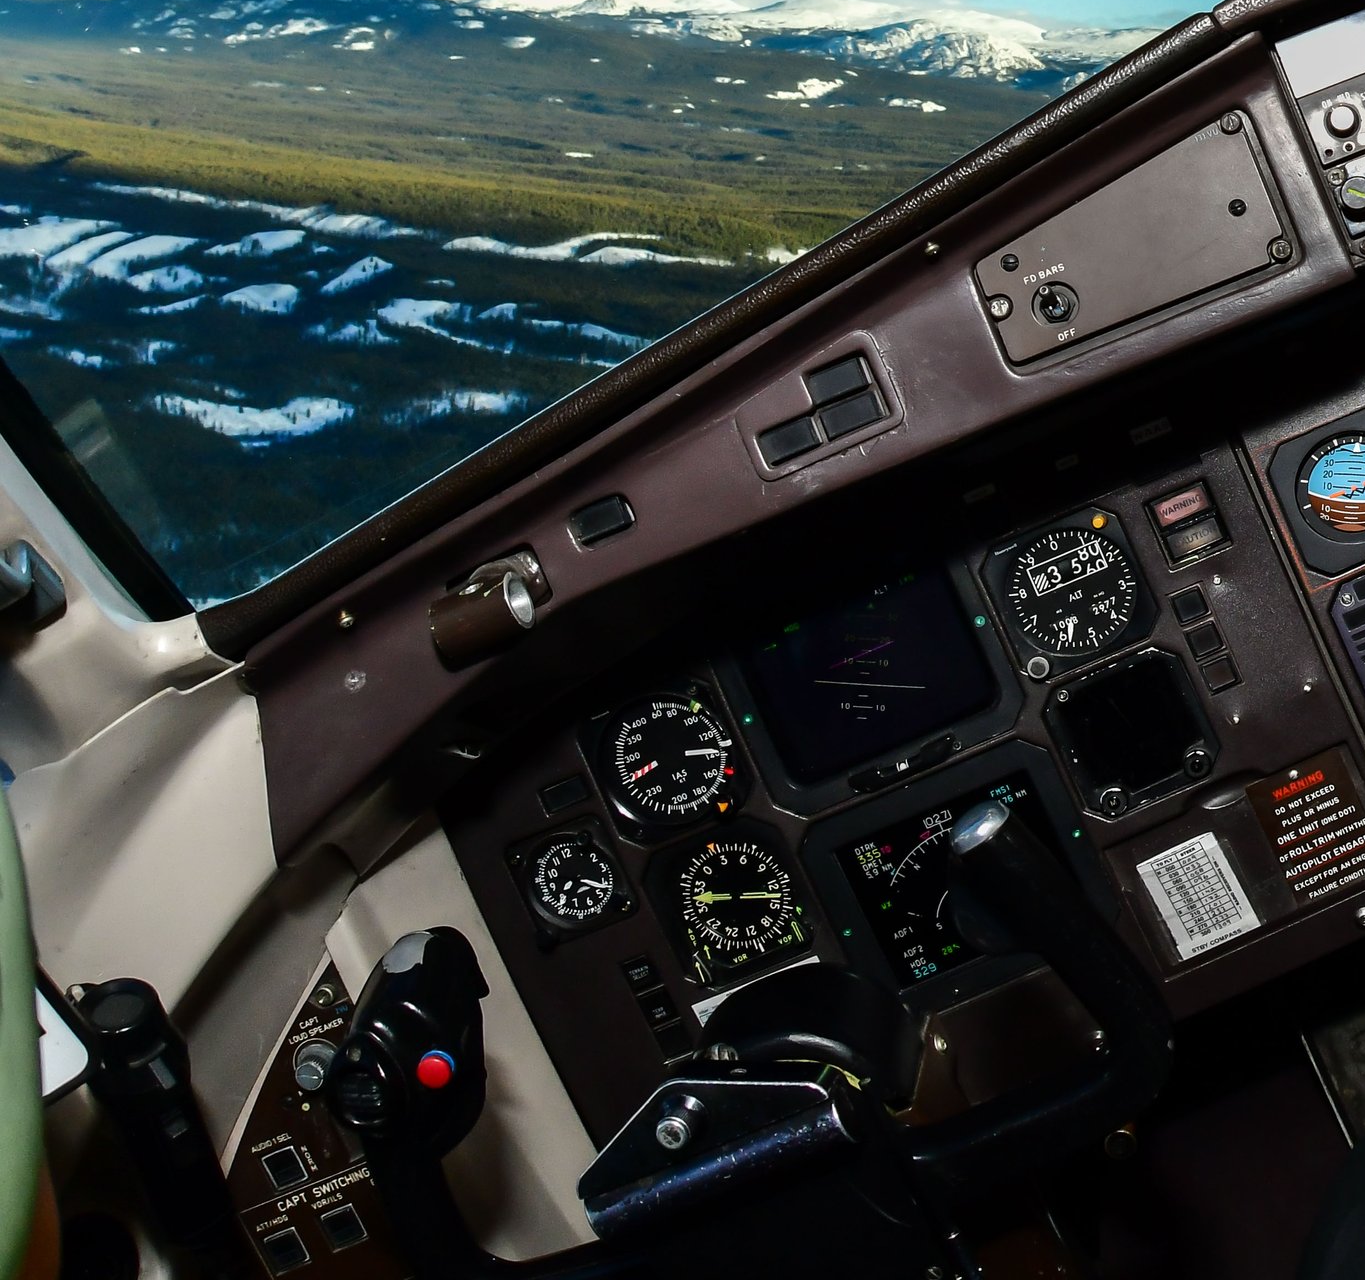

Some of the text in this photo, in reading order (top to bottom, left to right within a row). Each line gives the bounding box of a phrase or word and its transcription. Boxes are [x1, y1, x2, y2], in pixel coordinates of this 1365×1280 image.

[1024, 263, 1065, 286] FD BARS
[1058, 327, 1077, 342] OFF
[1069, 589, 1083, 603] ALT
[646, 786, 662, 797] 230
[990, 785, 1010, 798] FMS1
[1272, 771, 1324, 800] WARNING
[672, 793, 688, 804] 200
[1275, 784, 1335, 816] DO NOT EXCEED
[1282, 797, 1340, 827] PLUS OR MINUS
[1277, 821, 1320, 845] ONE UNIT
[858, 849, 881, 865] 335
[1289, 832, 1336, 859] ROLL TRIM
[1285, 851, 1333, 879] AUTOPILOT
[1309, 881, 1338, 899] FAILURE
[1192, 928, 1242, 953] STBY COMPASS
[913, 963, 937, 978] 329
[289, 1018, 344, 1045] LOUD SPEAKER
[277, 1168, 370, 1212] CAPT SWITCHING
